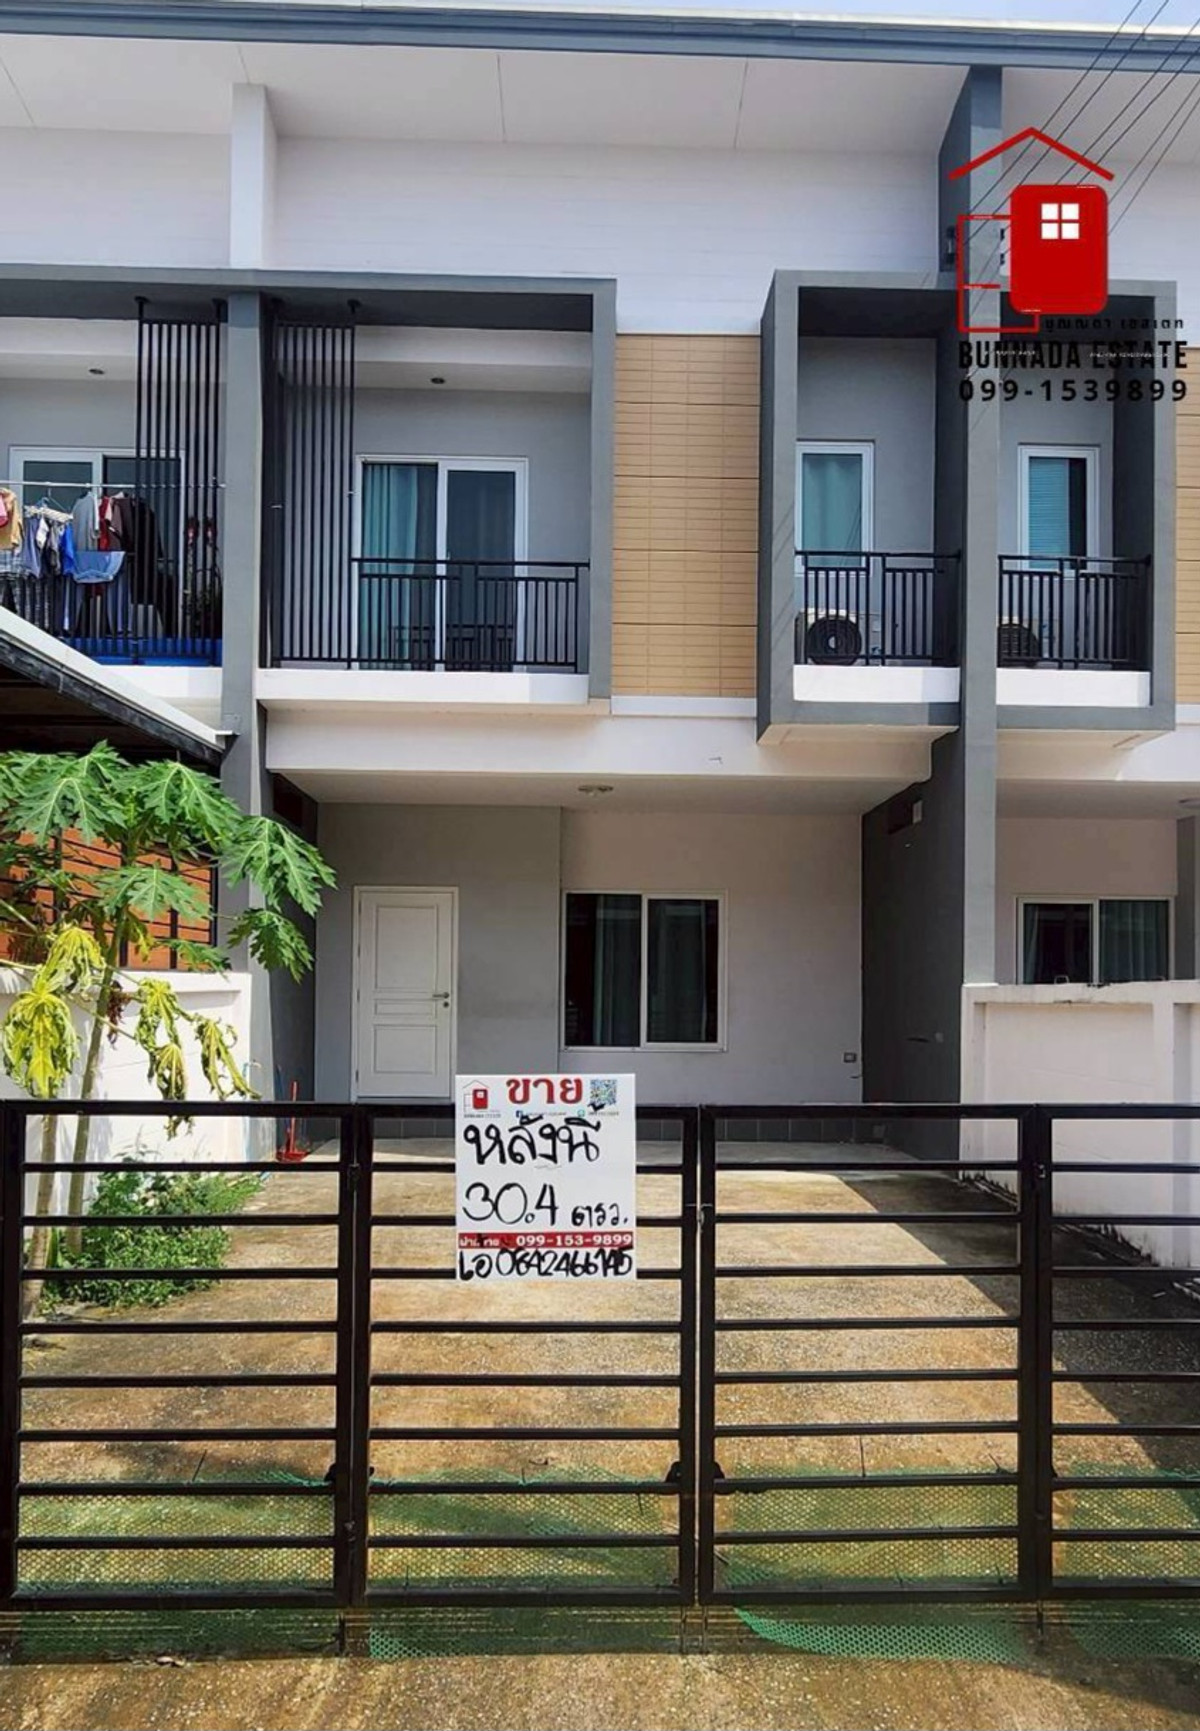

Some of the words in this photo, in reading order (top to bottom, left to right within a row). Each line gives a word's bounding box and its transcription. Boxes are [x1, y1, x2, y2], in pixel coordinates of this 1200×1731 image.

[506, 1077, 584, 1105] ขาย
[463, 1103, 601, 1165] หลังนี้
[462, 1182, 559, 1226] 30.4
[515, 1234, 633, 1247] 099-153-9899
